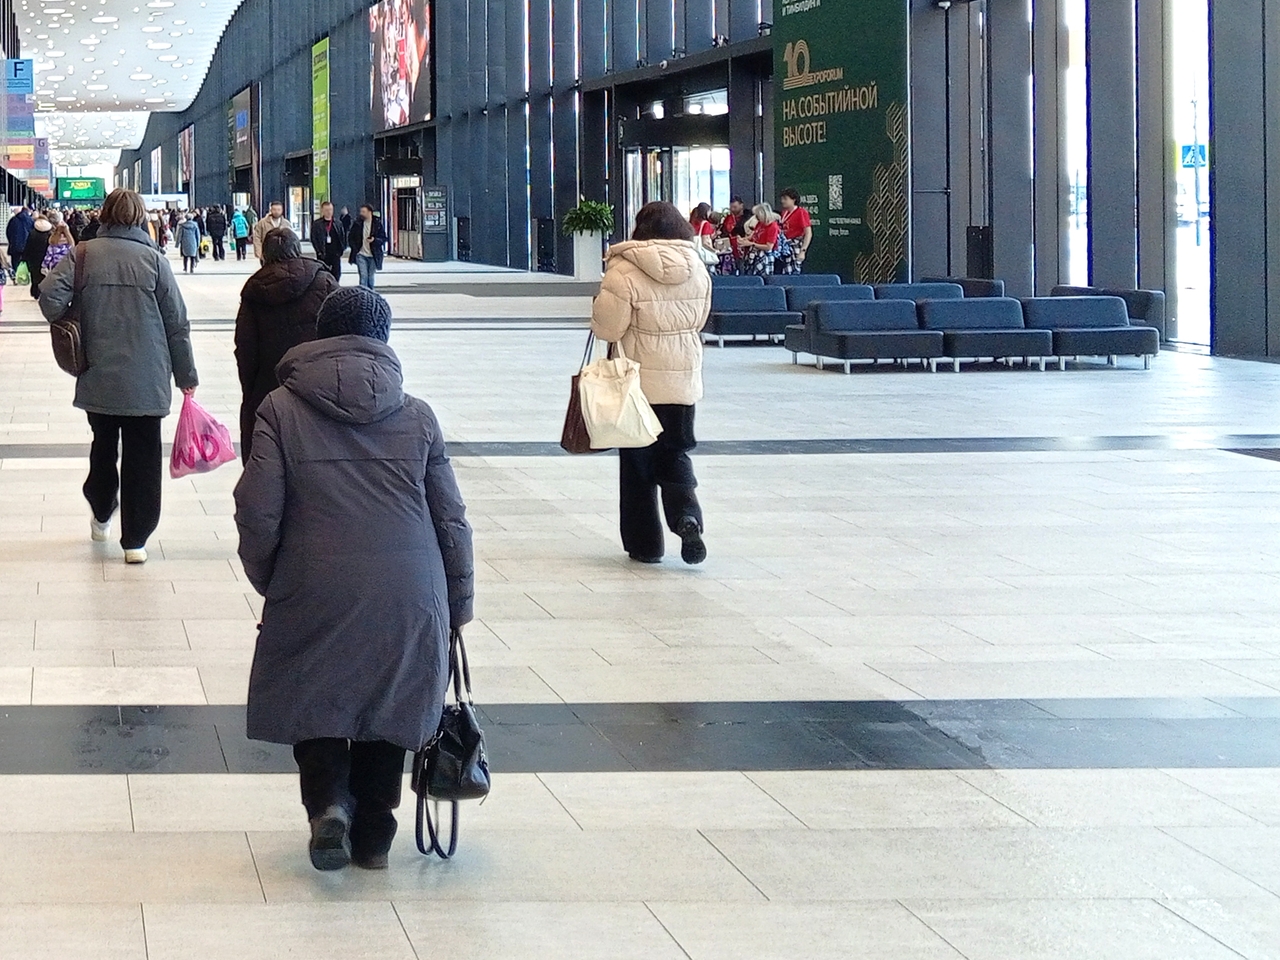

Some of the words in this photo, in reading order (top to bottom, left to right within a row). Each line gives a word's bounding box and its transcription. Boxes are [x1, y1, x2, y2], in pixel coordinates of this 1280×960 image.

[13, 61, 25, 78] F
[783, 99, 798, 121] НА
[798, 81, 878, 118] СОБЫТИЙНОЙ
[38, 138, 45, 148] G
[783, 121, 827, 148] ВЫСОТЕ!
